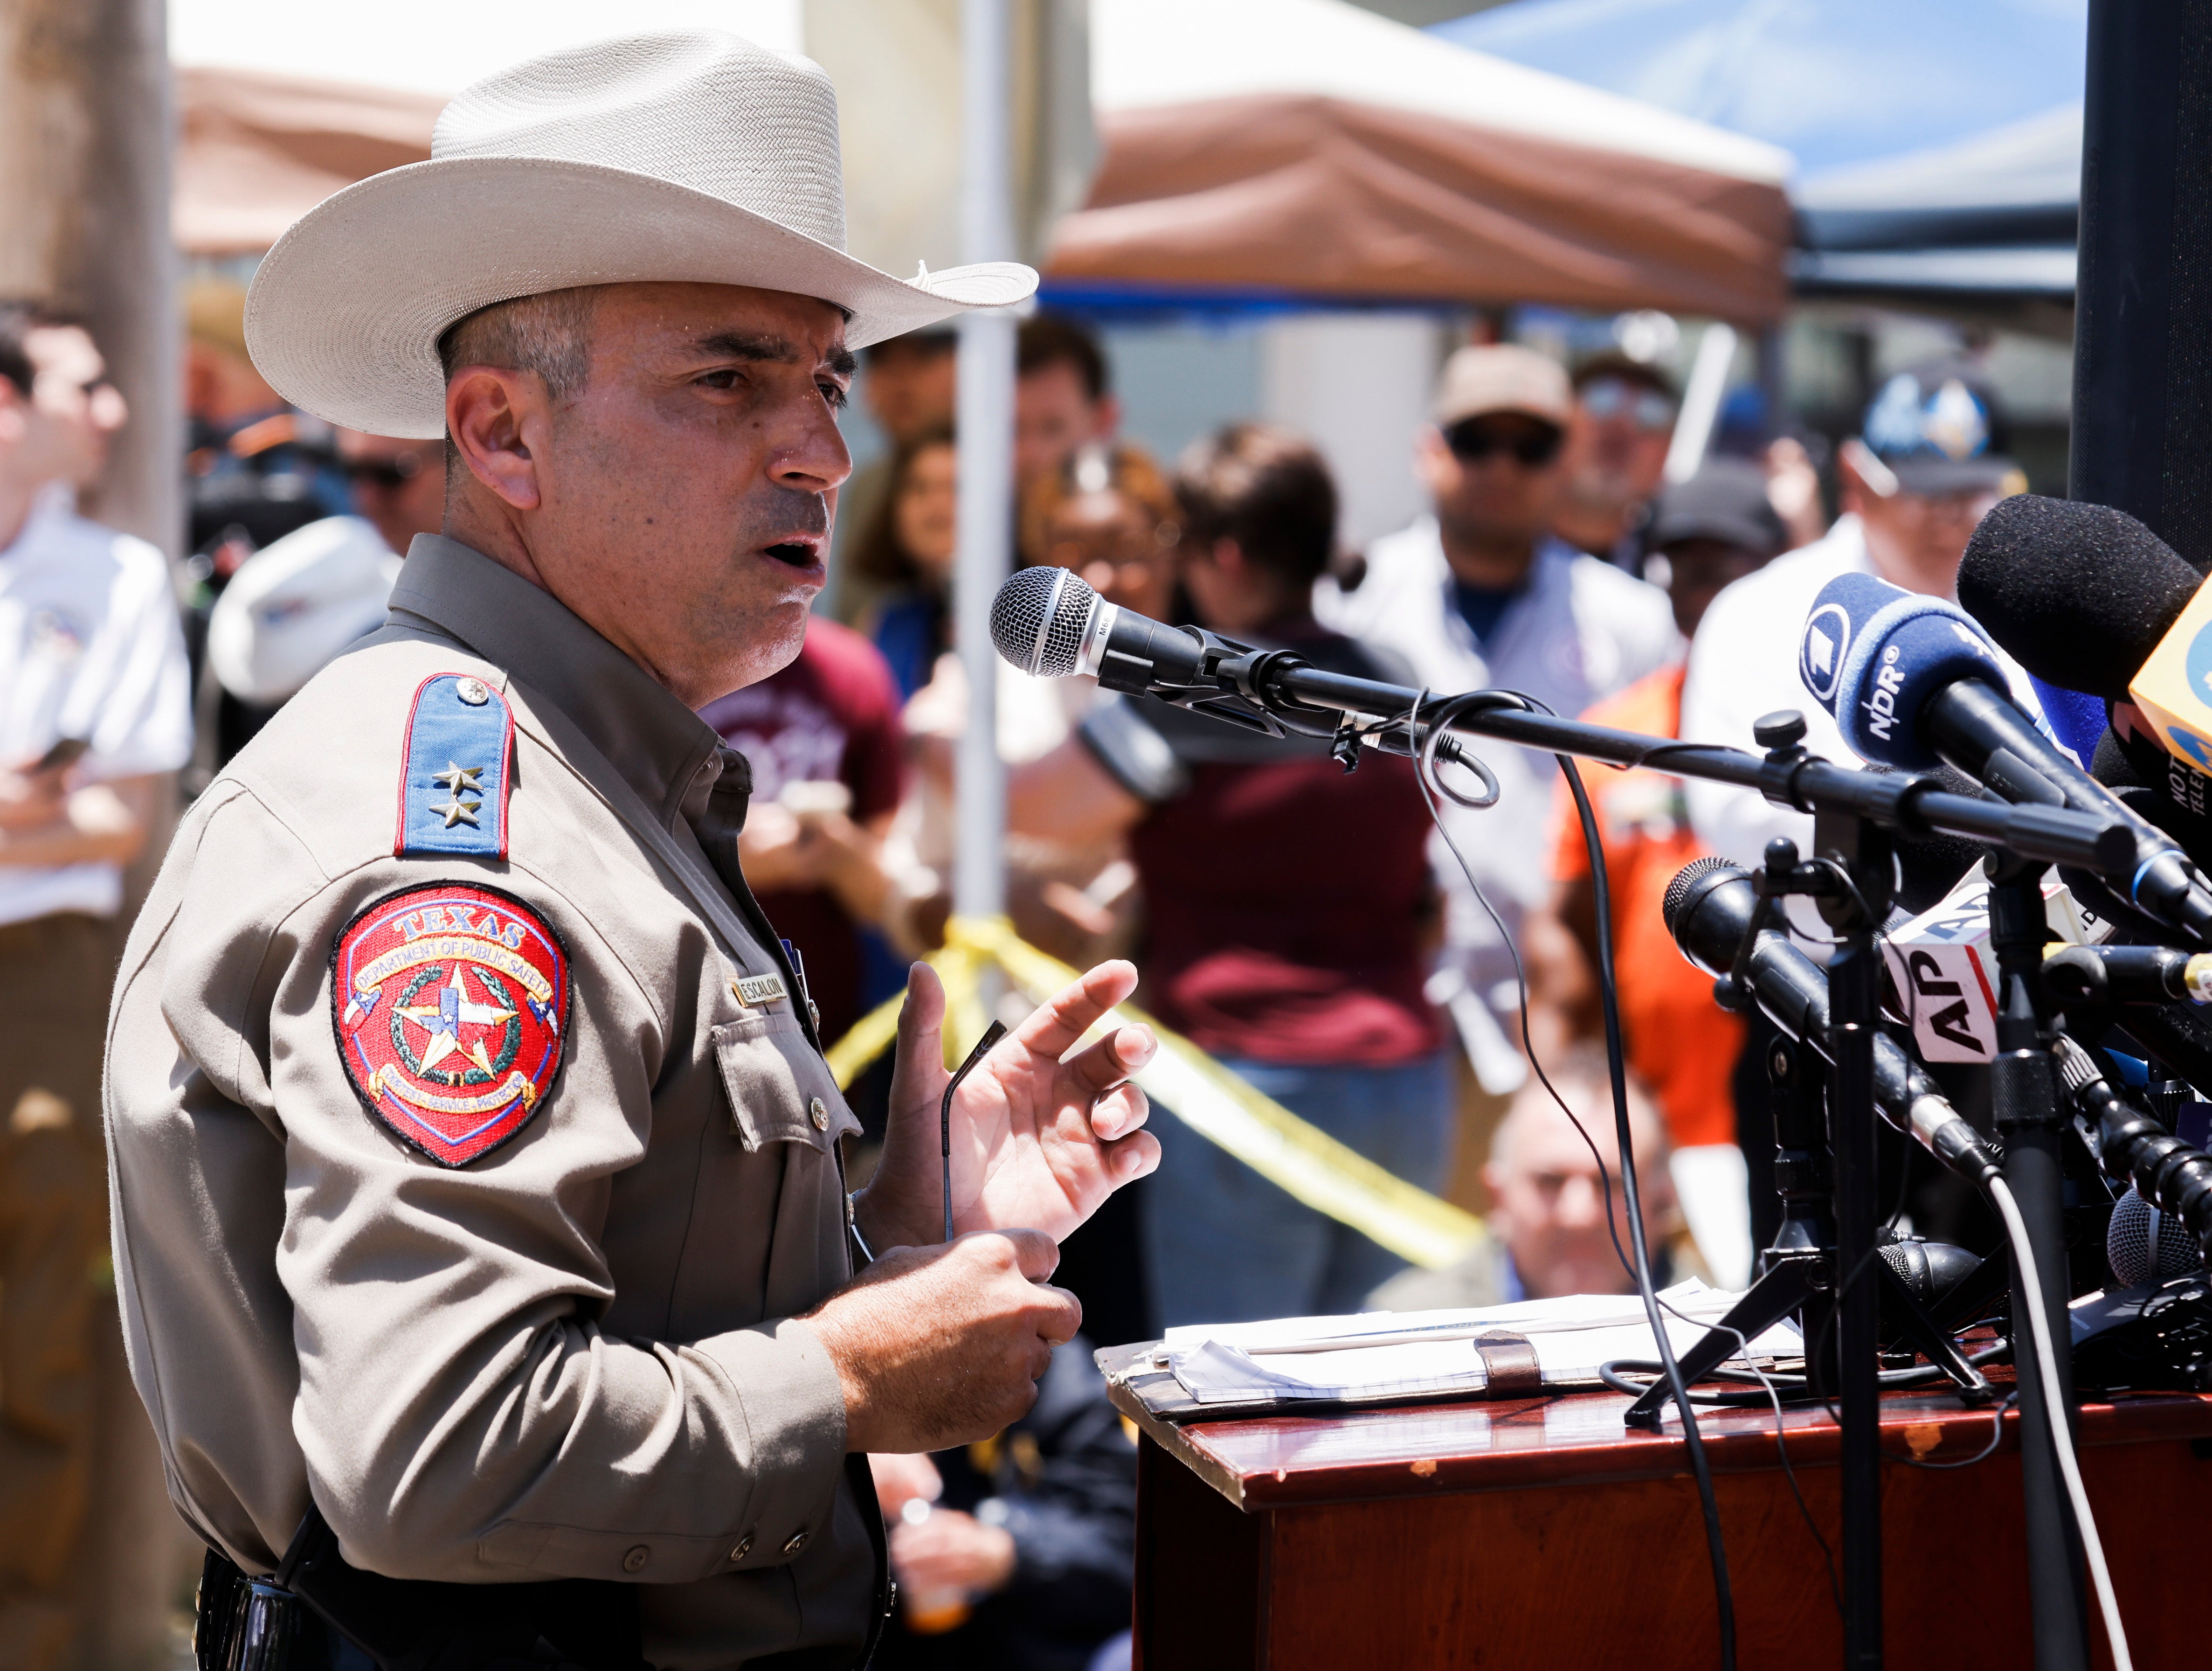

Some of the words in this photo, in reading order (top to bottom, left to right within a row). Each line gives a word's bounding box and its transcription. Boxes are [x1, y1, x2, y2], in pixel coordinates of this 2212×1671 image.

[1099, 617, 1110, 636] M68
[393, 907, 526, 950] TEXAS
[357, 943, 436, 988] DEPARTMENT
[441, 942, 458, 955] OF
[462, 943, 506, 966] PUBLIC
[508, 959, 551, 995] SAFETY
[741, 978, 783, 1000] ESCALON
[1909, 950, 1986, 1054] AP
[428, 1096, 470, 1111] SERVICE
[477, 1073, 525, 1109] PROTECTION
